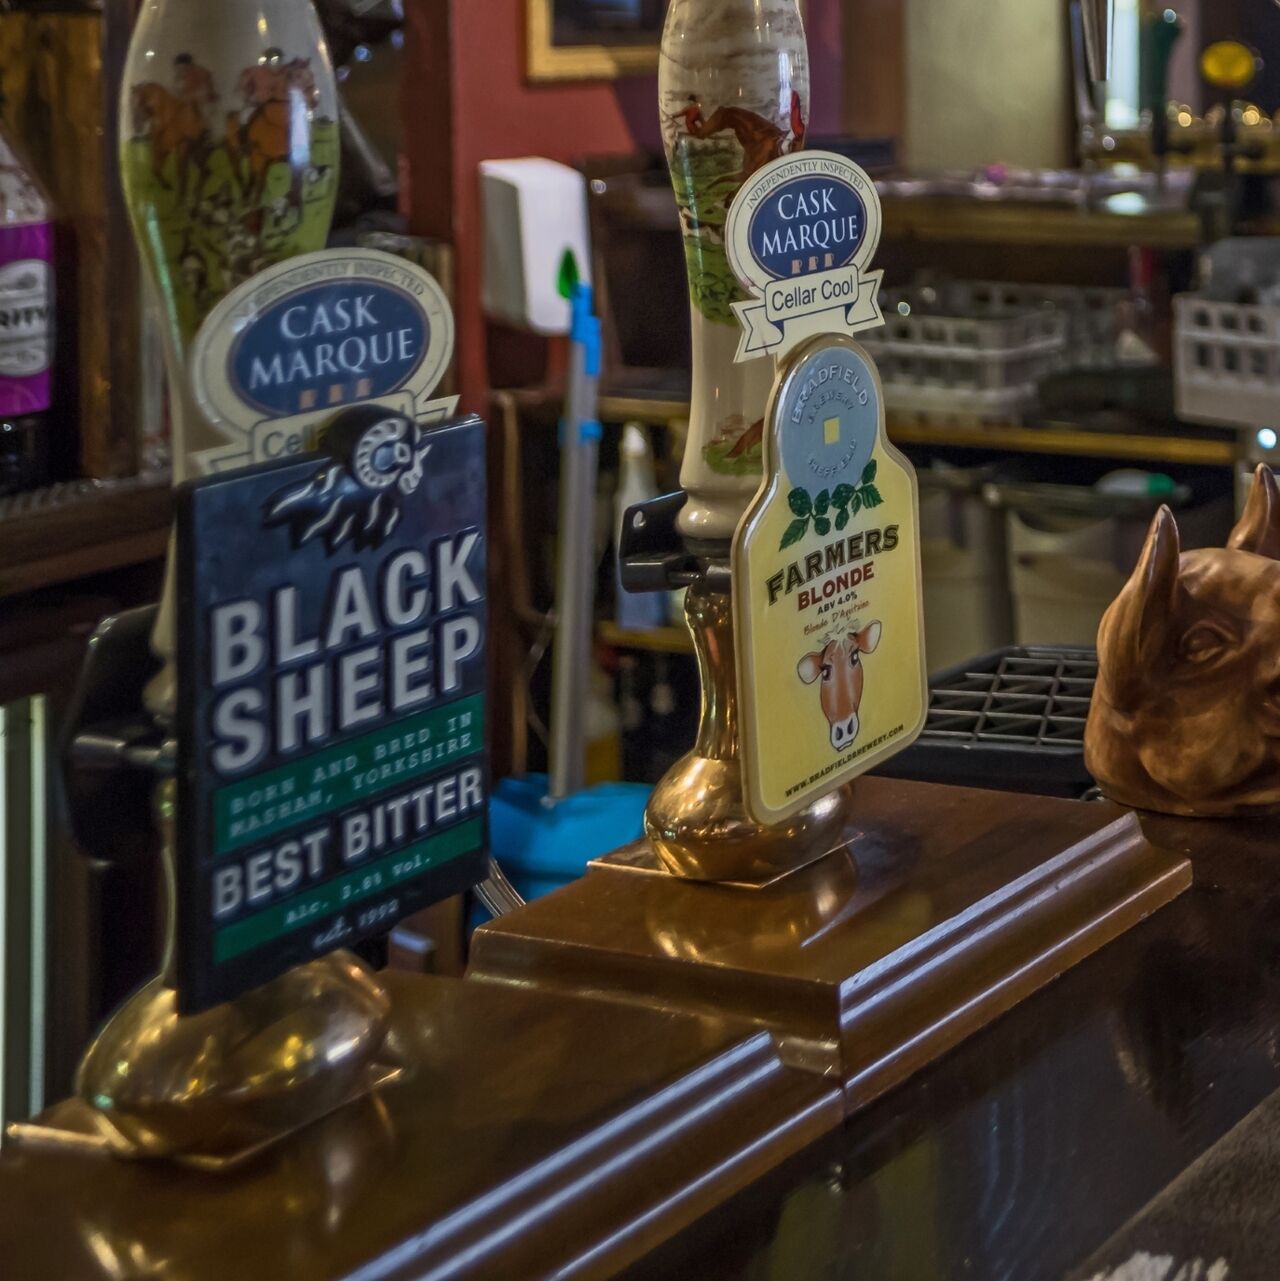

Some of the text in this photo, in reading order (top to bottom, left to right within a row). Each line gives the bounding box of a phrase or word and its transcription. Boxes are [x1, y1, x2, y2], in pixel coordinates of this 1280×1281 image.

[747, 160, 864, 210] INDEPENDENTLY INSPECTED
[777, 187, 837, 220] CASK
[761, 215, 859, 257] MARQUE
[279, 293, 379, 341] CASK
[771, 274, 854, 312] Cellar Cool
[249, 327, 415, 391] MARQUE
[791, 364, 869, 424] BRADFIELD
[765, 524, 900, 607] FARMERS
[797, 561, 875, 612] BLONDE
[211, 530, 482, 687] BLACK
[817, 590, 858, 616] ABV 4.0%
[212, 615, 481, 773] SHEEP
[229, 710, 473, 816] BORN AND BRED IN
[353, 731, 473, 791] YORKSHIRE
[784, 723, 905, 798] WWW.BRADFIELDBREWERY.COM
[213, 766, 482, 918] BEST BITTER
